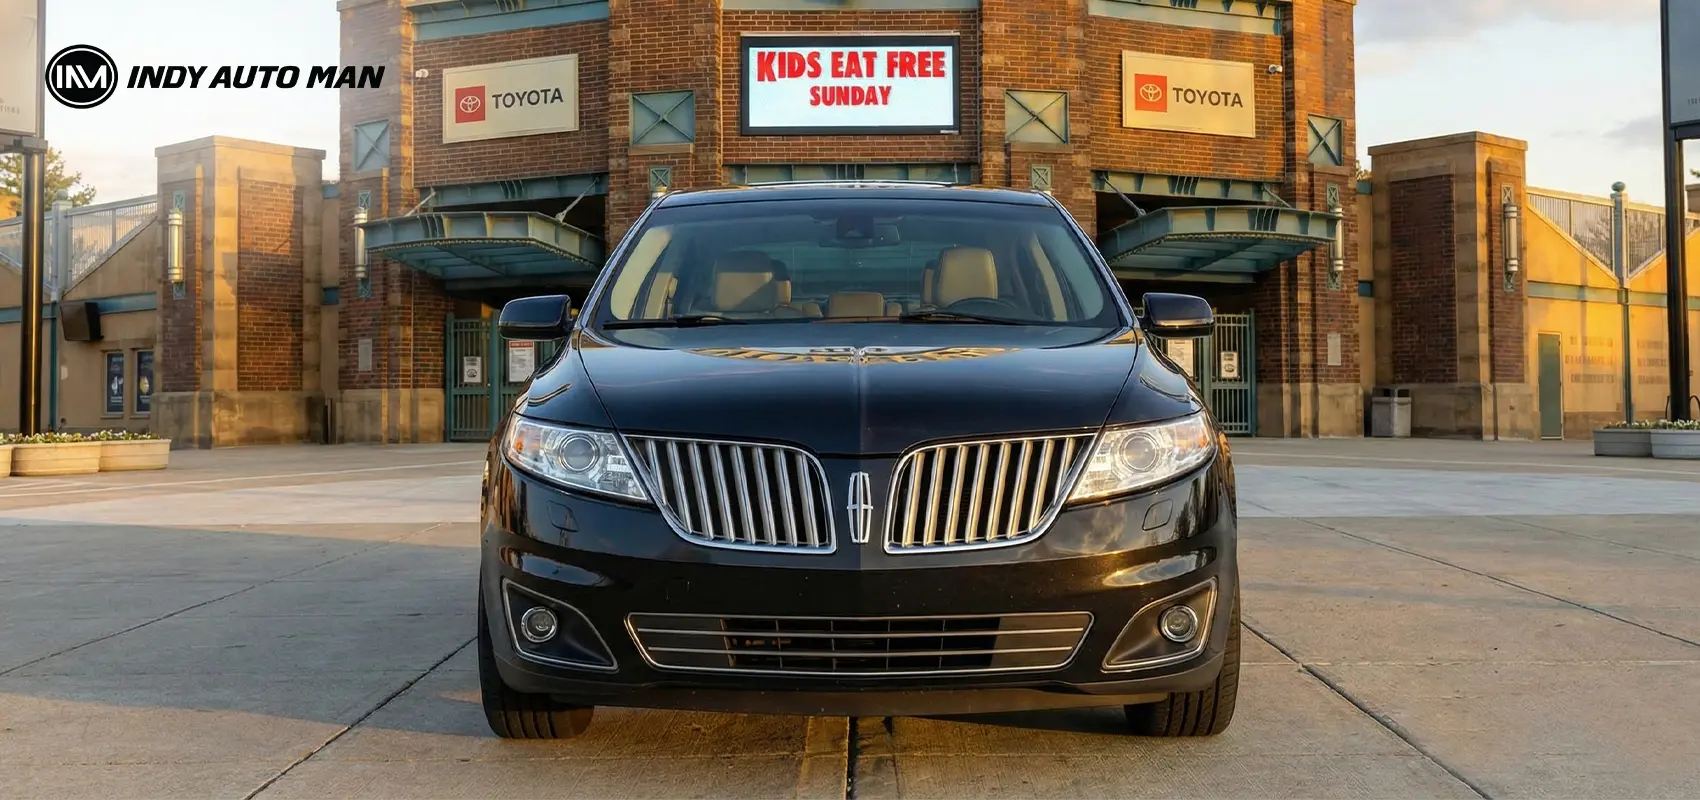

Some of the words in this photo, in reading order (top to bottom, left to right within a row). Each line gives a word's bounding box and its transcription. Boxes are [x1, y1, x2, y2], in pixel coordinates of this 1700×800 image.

[757, 51, 823, 82] KIDS
[831, 51, 877, 78] EAT
[886, 51, 946, 78] FREE
[491, 87, 564, 109] TOYOTA
[810, 86, 892, 106] SUNDAY
[1172, 87, 1244, 108] TOYOTA
